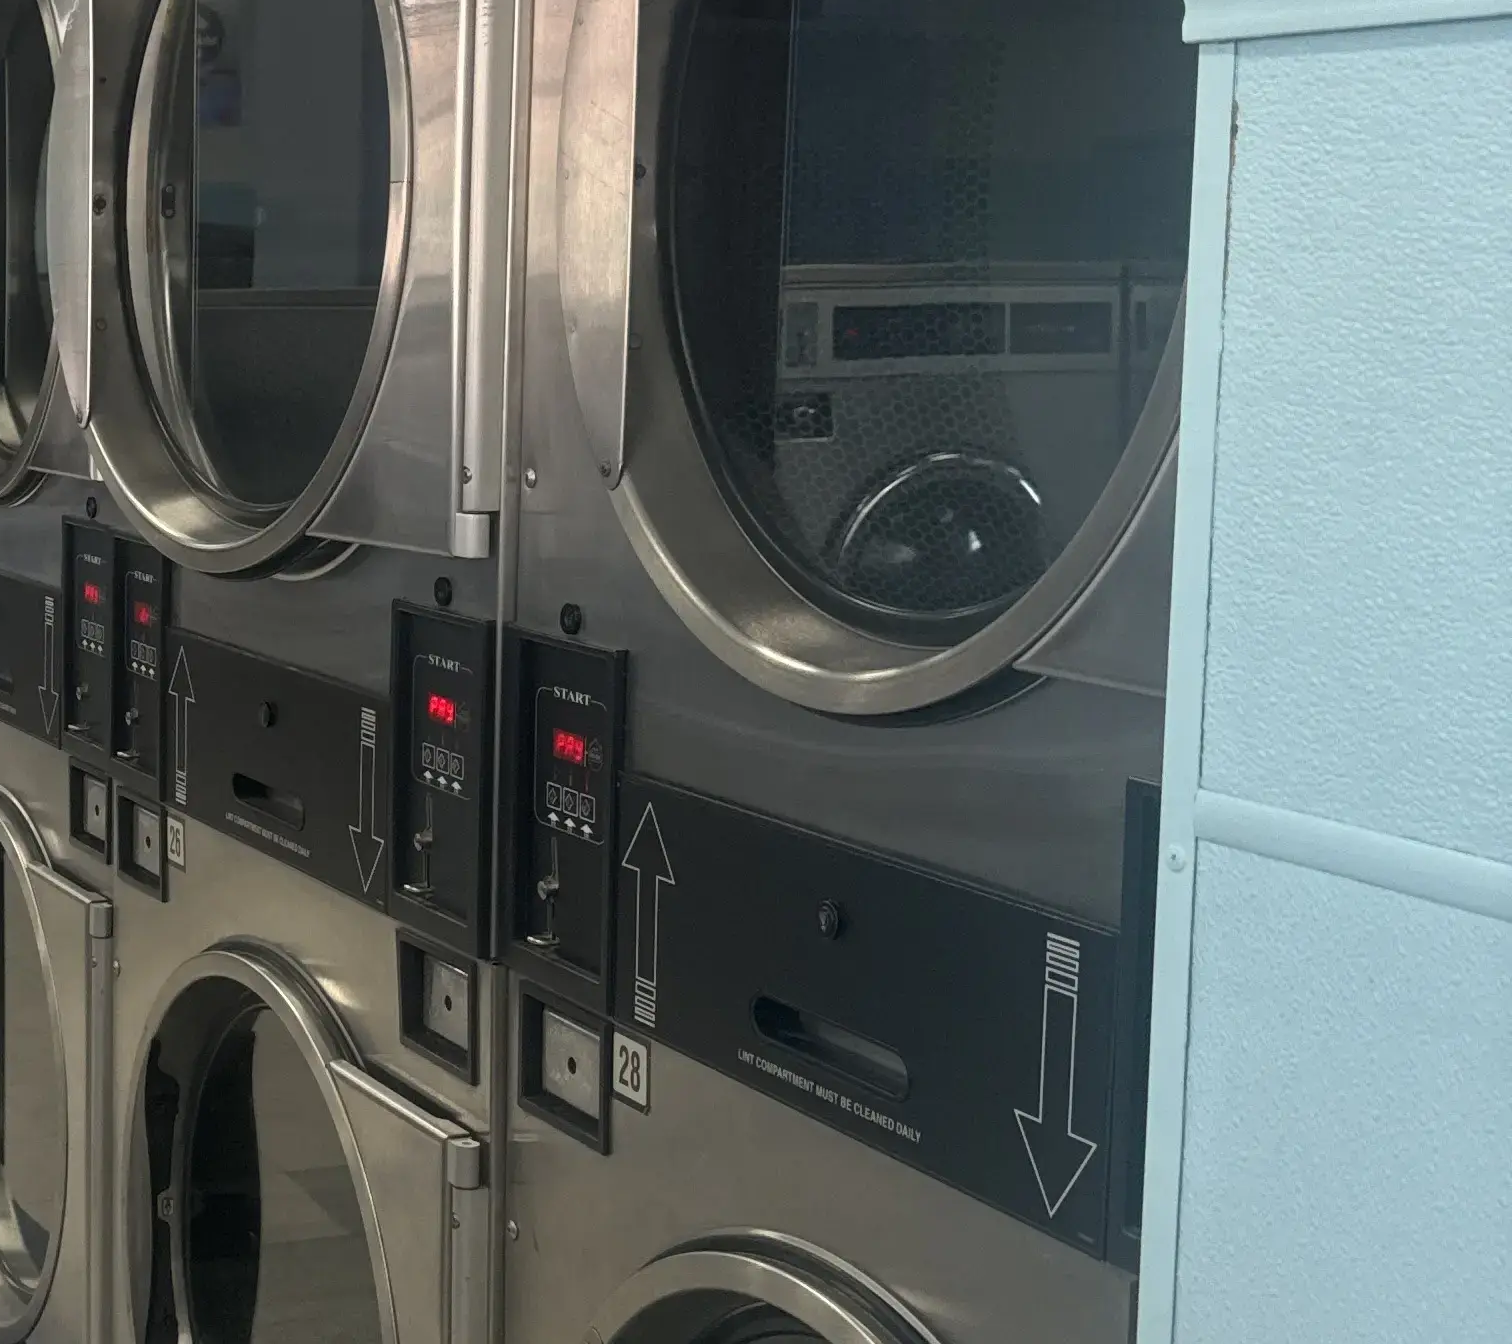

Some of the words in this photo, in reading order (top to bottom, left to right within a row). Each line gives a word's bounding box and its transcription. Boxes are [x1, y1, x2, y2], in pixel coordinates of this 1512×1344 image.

[428, 653, 460, 673] START
[553, 686, 591, 706] START
[169, 824, 181, 857] 26
[619, 1044, 641, 1094] 28
[738, 1048, 754, 1065] LINT
[756, 1057, 814, 1093] COMPARTMENT
[816, 1084, 838, 1105] MUST
[840, 1096, 852, 1112] BE
[854, 1102, 894, 1131] CLEANED
[896, 1121, 921, 1143] DAILY
